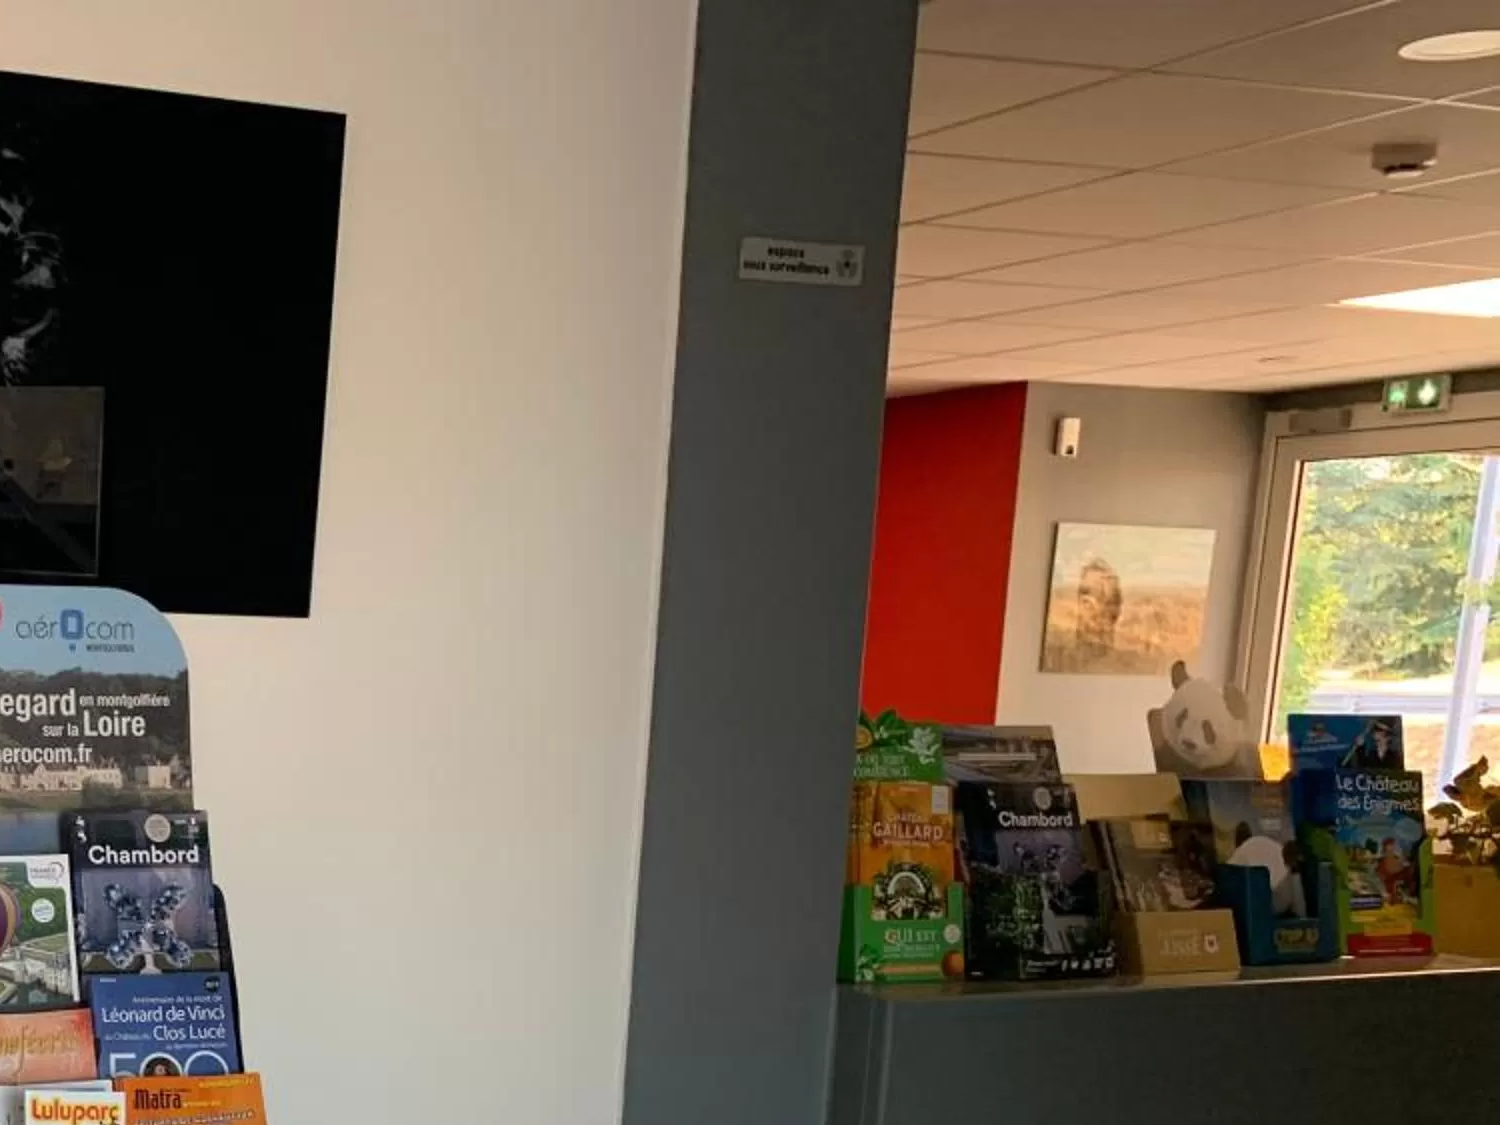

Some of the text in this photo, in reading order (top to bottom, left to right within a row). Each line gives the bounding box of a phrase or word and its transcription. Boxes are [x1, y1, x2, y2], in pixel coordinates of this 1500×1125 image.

[80, 695, 94, 706] en
[42, 710, 146, 737] sur la Loire
[1355, 773, 1420, 795] Château
[999, 811, 1073, 828] Chambord
[873, 821, 943, 841] GAILLARD
[88, 844, 200, 865] Chambord
[102, 1003, 225, 1024] Léonard de Vinci
[153, 1025, 186, 1042] Clos
[188, 1023, 227, 1040] Lucé
[134, 1088, 182, 1111] Matra
